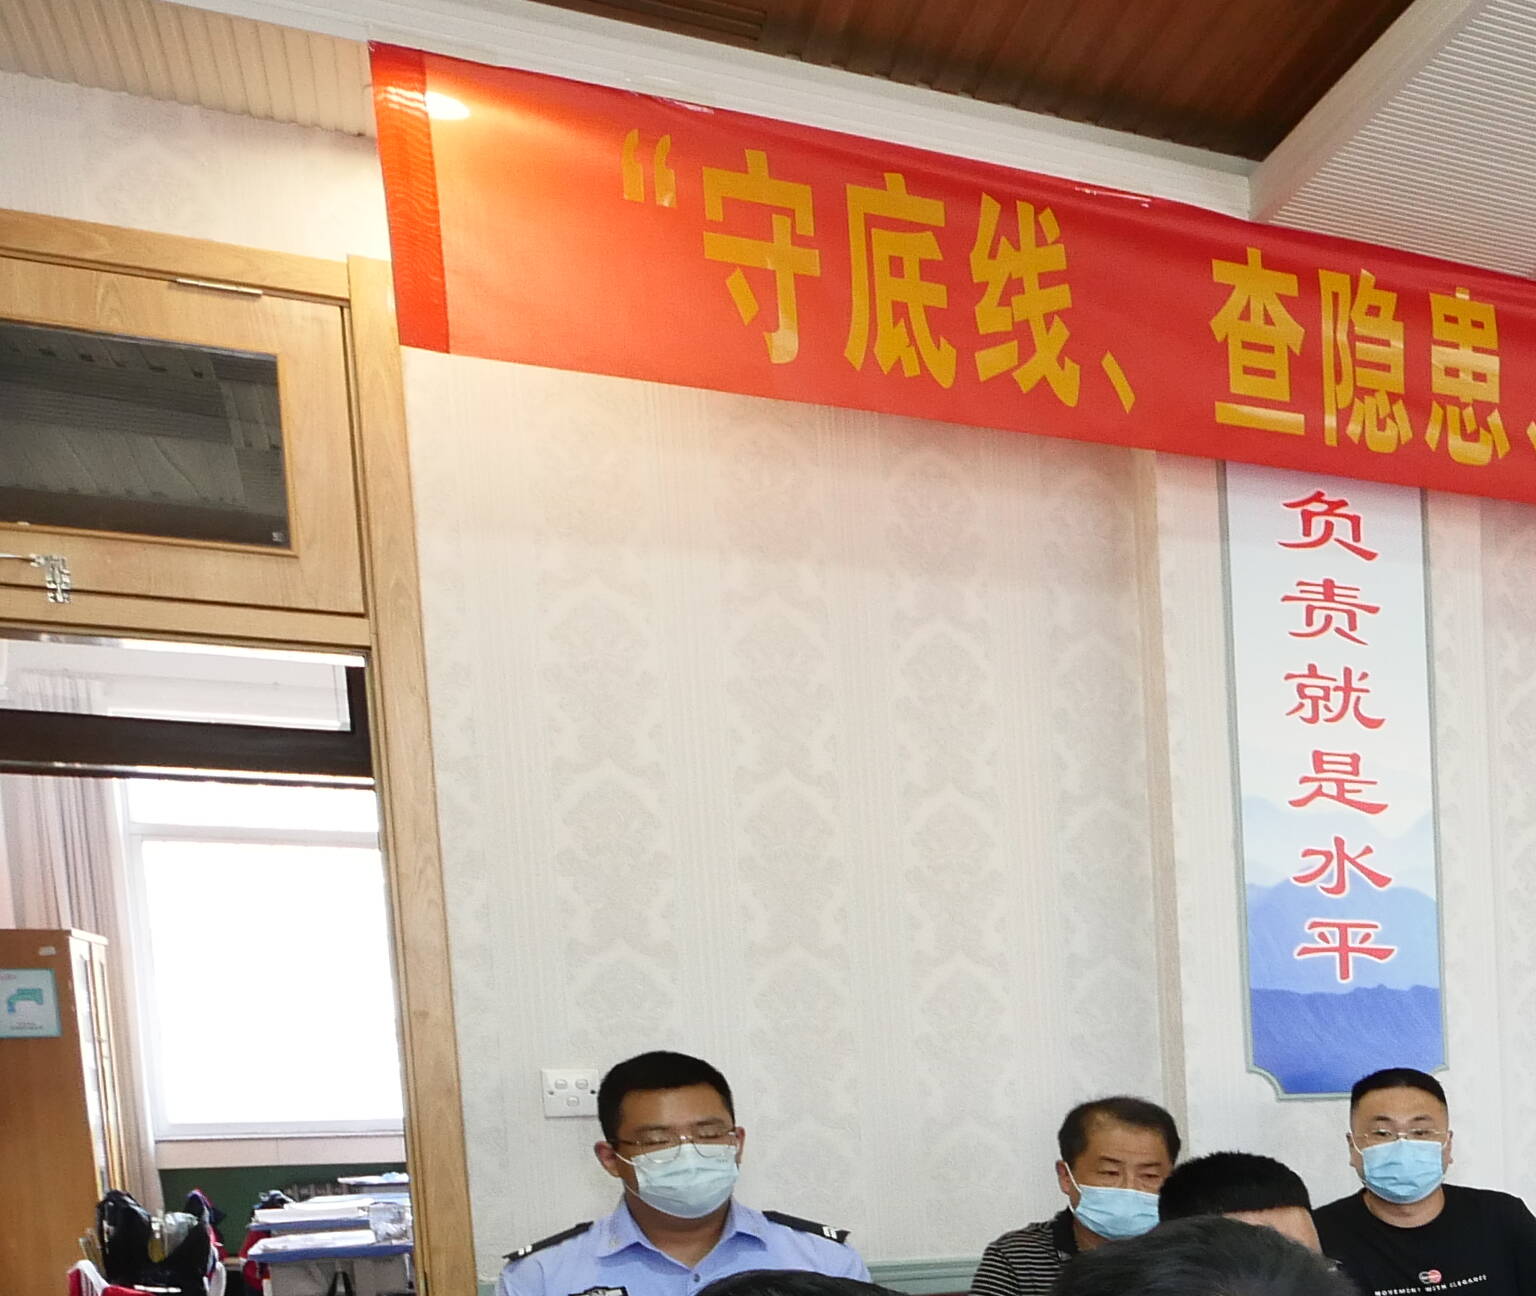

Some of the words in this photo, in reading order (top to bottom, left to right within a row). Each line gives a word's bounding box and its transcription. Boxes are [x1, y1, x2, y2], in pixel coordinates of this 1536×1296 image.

[1276, 489, 1399, 982] 负责就是水平
